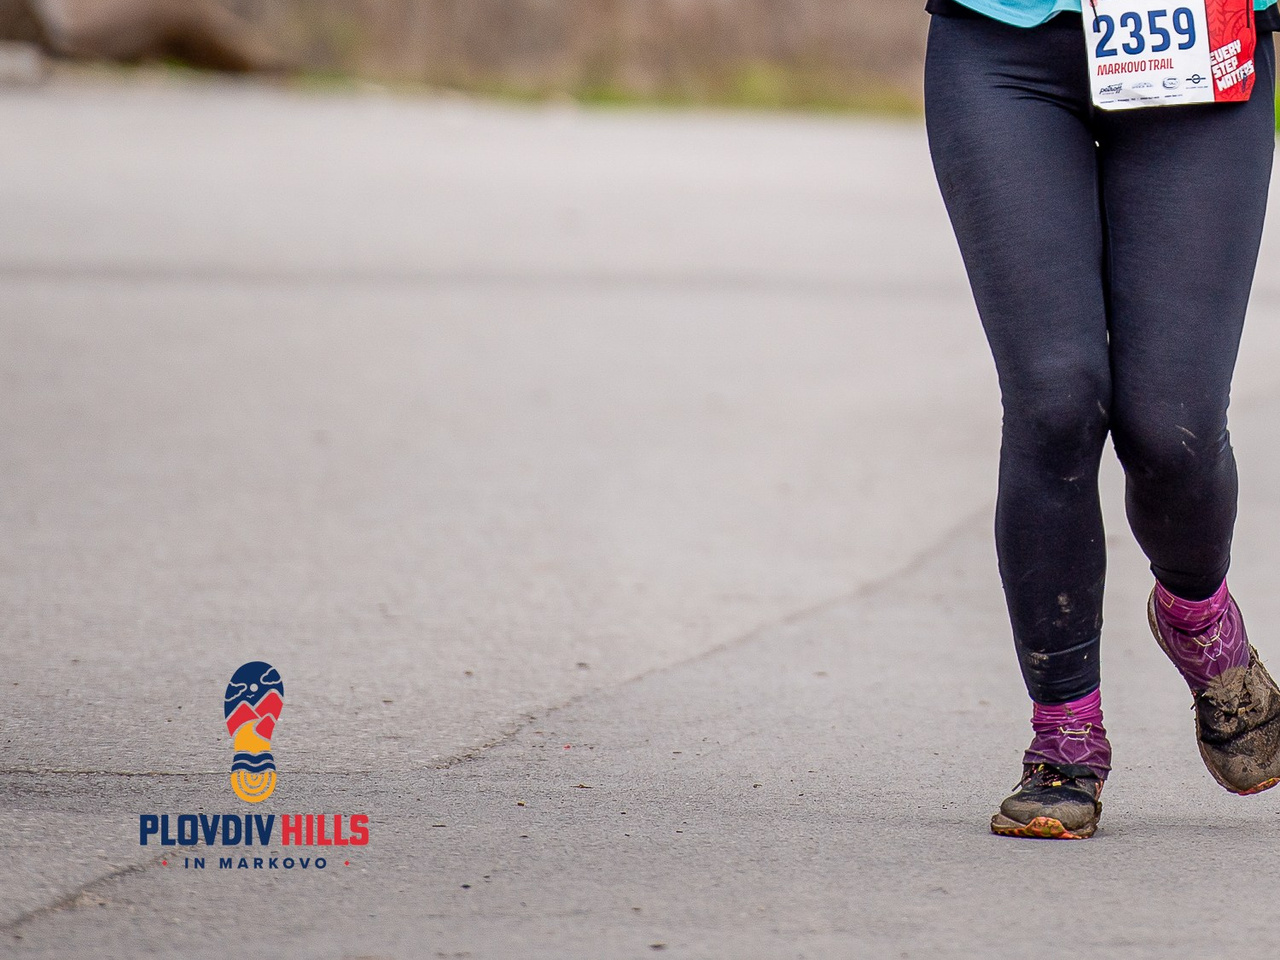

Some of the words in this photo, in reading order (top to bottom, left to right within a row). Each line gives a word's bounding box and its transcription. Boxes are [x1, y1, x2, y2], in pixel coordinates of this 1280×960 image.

[1092, 7, 1196, 58] 2359
[1210, 39, 1242, 64] EVERY
[1097, 60, 1147, 76] MARKOVO
[1148, 58, 1174, 71] TRAIL
[1211, 55, 1239, 79] STEP
